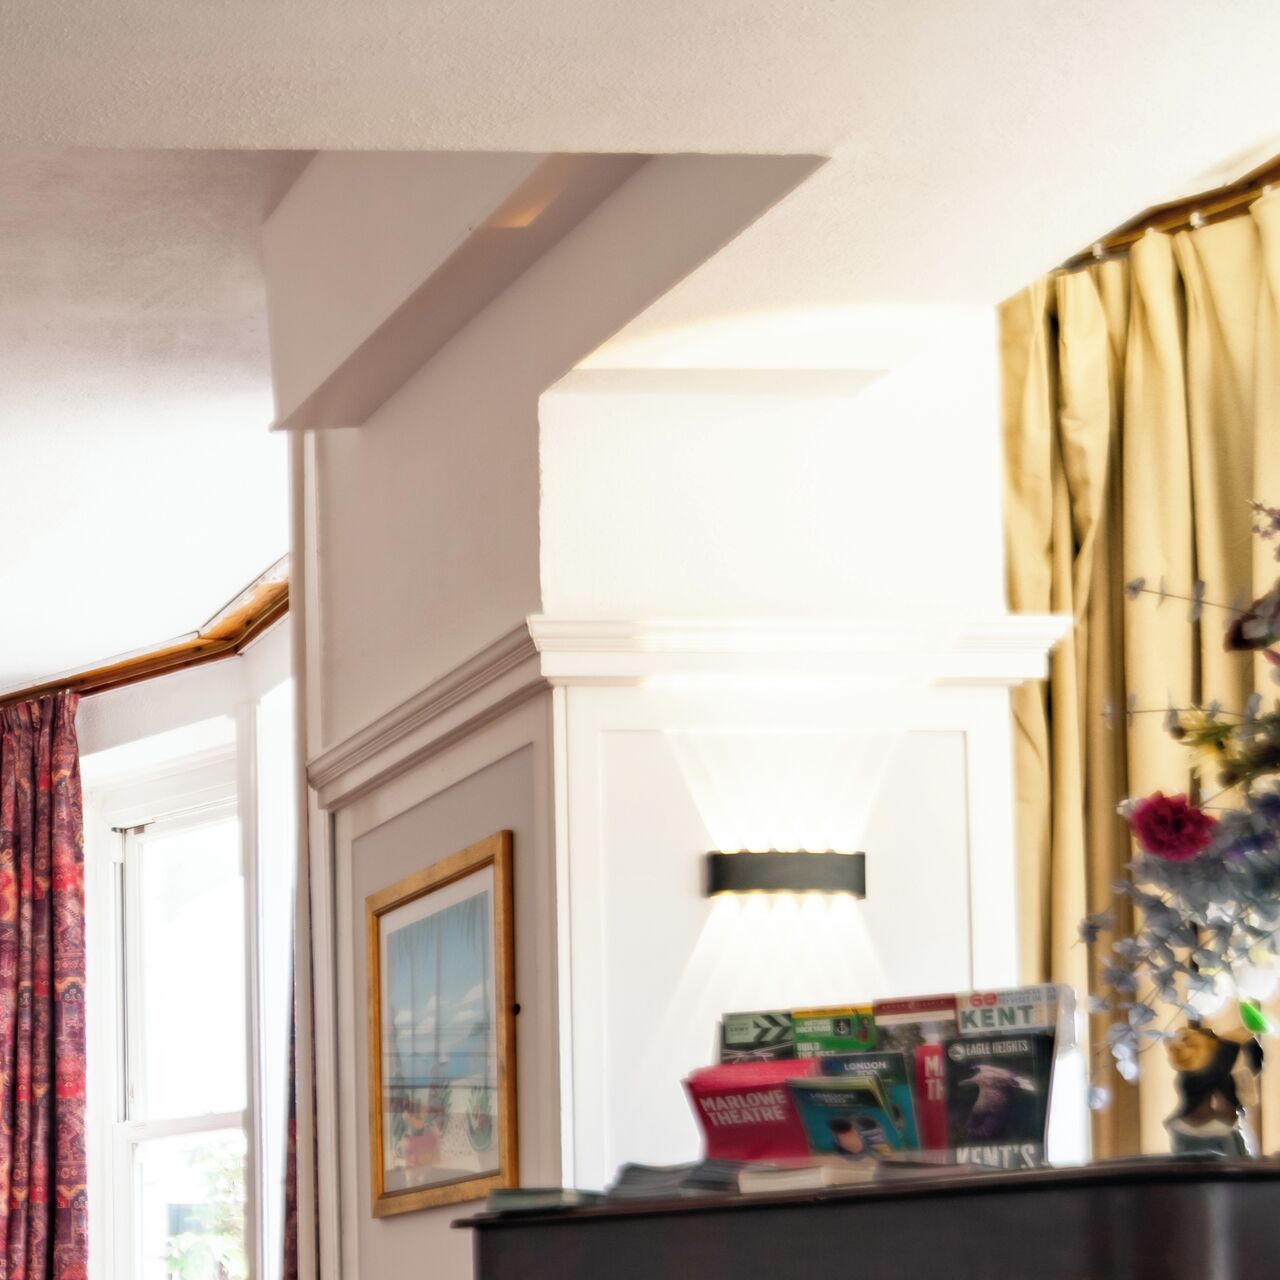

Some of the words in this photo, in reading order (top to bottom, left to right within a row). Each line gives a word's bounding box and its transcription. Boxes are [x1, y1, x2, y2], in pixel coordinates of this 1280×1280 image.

[960, 1005, 1034, 1030] KENT
[966, 1043, 991, 1056] EAGLE
[993, 1040, 1029, 1054] HEIGHTS
[843, 1060, 887, 1070] LONDON
[699, 1090, 788, 1113] MARLOWE
[707, 1104, 786, 1127] THEATRE
